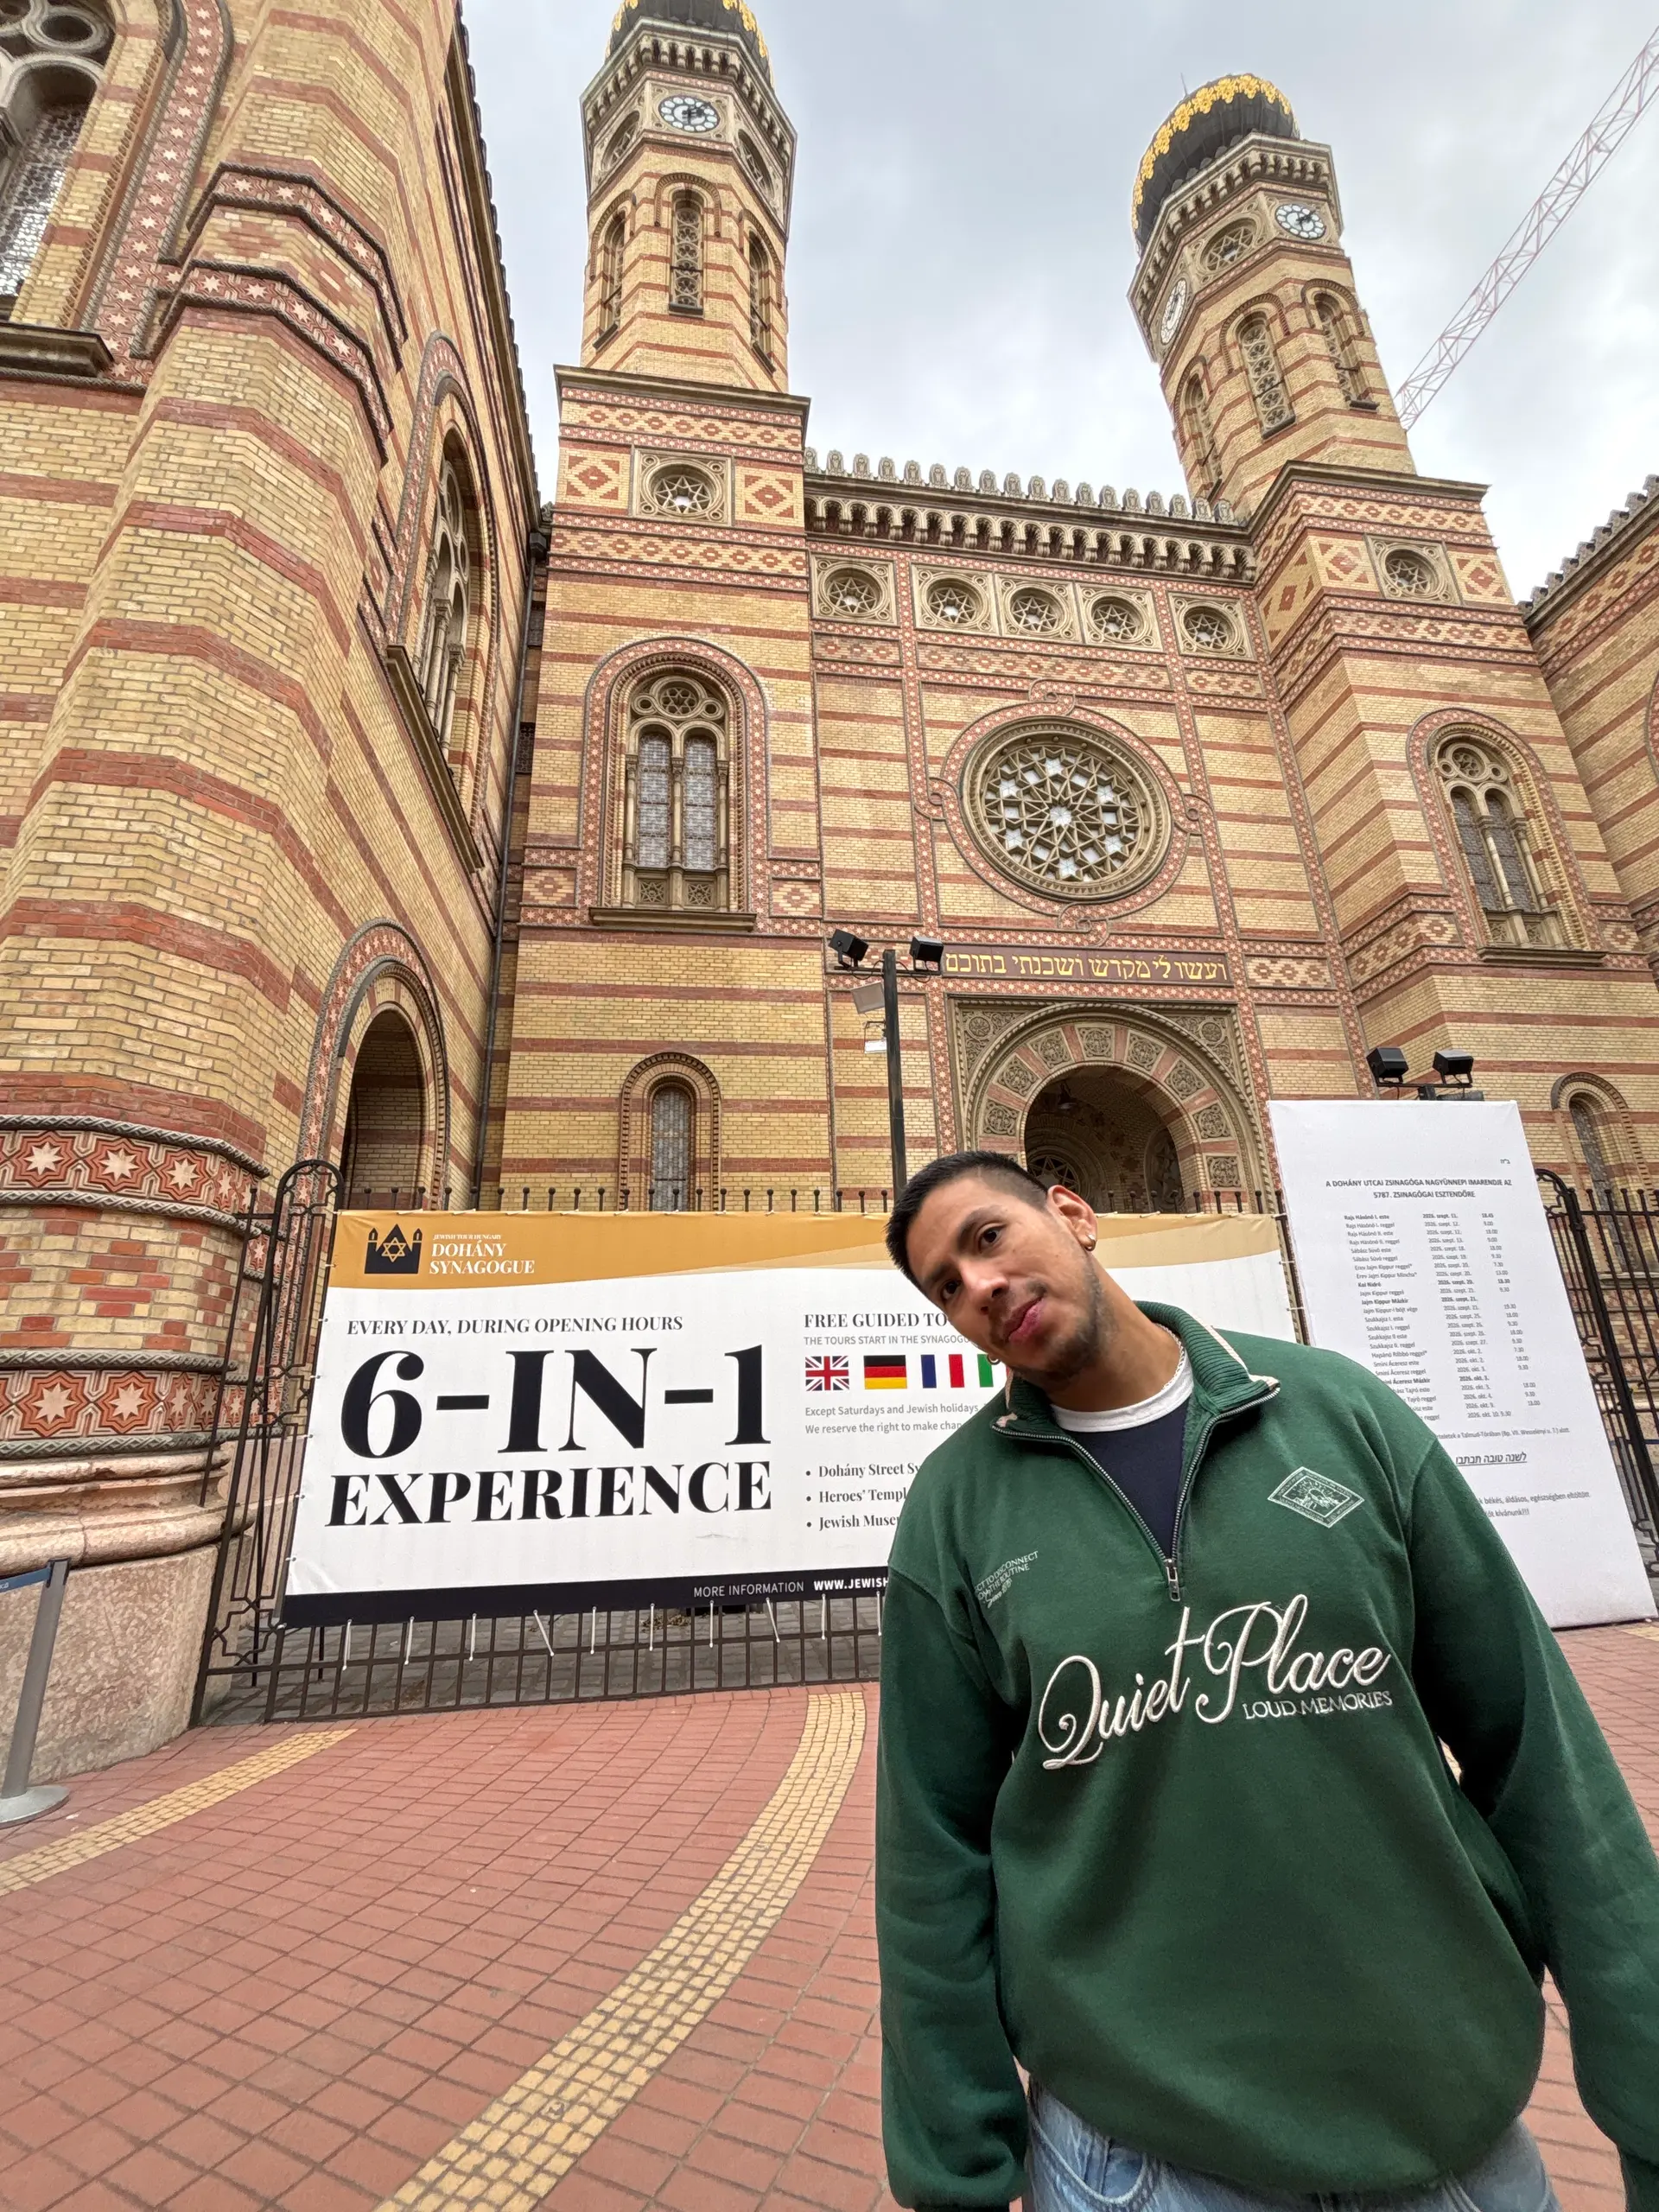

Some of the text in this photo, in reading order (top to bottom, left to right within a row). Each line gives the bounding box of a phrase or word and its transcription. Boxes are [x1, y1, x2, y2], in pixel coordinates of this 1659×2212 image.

[946, 953, 1227, 980] ועשו לי מקדש ושכנתי בתוכם
[1332, 1179, 1362, 1187] DOHÁNY
[1385, 1178, 1424, 1186] ZSINAGÓGA
[1393, 1190, 1434, 1198] ZSINAGÓGAI
[1435, 1189, 1476, 1198] ESZTENDŐRE
[432, 1239, 507, 1257] DOHÁNY
[429, 1259, 535, 1274] SYNAGOGUE
[347, 1316, 683, 1336] EVERY DAY, DURING OPENING HOURS
[804, 1313, 948, 1328] FREE GUIDED TO
[804, 1335, 970, 1345] THE TOURS START IN THE SYNAGOGU
[340, 1344, 772, 1459] 6-IN-1
[805, 1402, 979, 1417] Except Saturdays and Jewish holidays
[805, 1421, 963, 1434] We reserve the right to make chan
[1484, 1454, 1503, 1463] טובה
[1505, 1451, 1527, 1462] לשנה
[819, 1463, 865, 1478] Dohány
[868, 1462, 905, 1475] Street
[325, 1460, 772, 1527] EXPERIENCE
[868, 1487, 907, 1503] Templ
[819, 1514, 860, 1532] Jewish
[694, 1577, 889, 1598] MORE INFORMATION WWW.JEWISH
[1038, 1594, 1391, 1770] Quiet Place
[1242, 1691, 1393, 1719] LOUD MEMORIES
